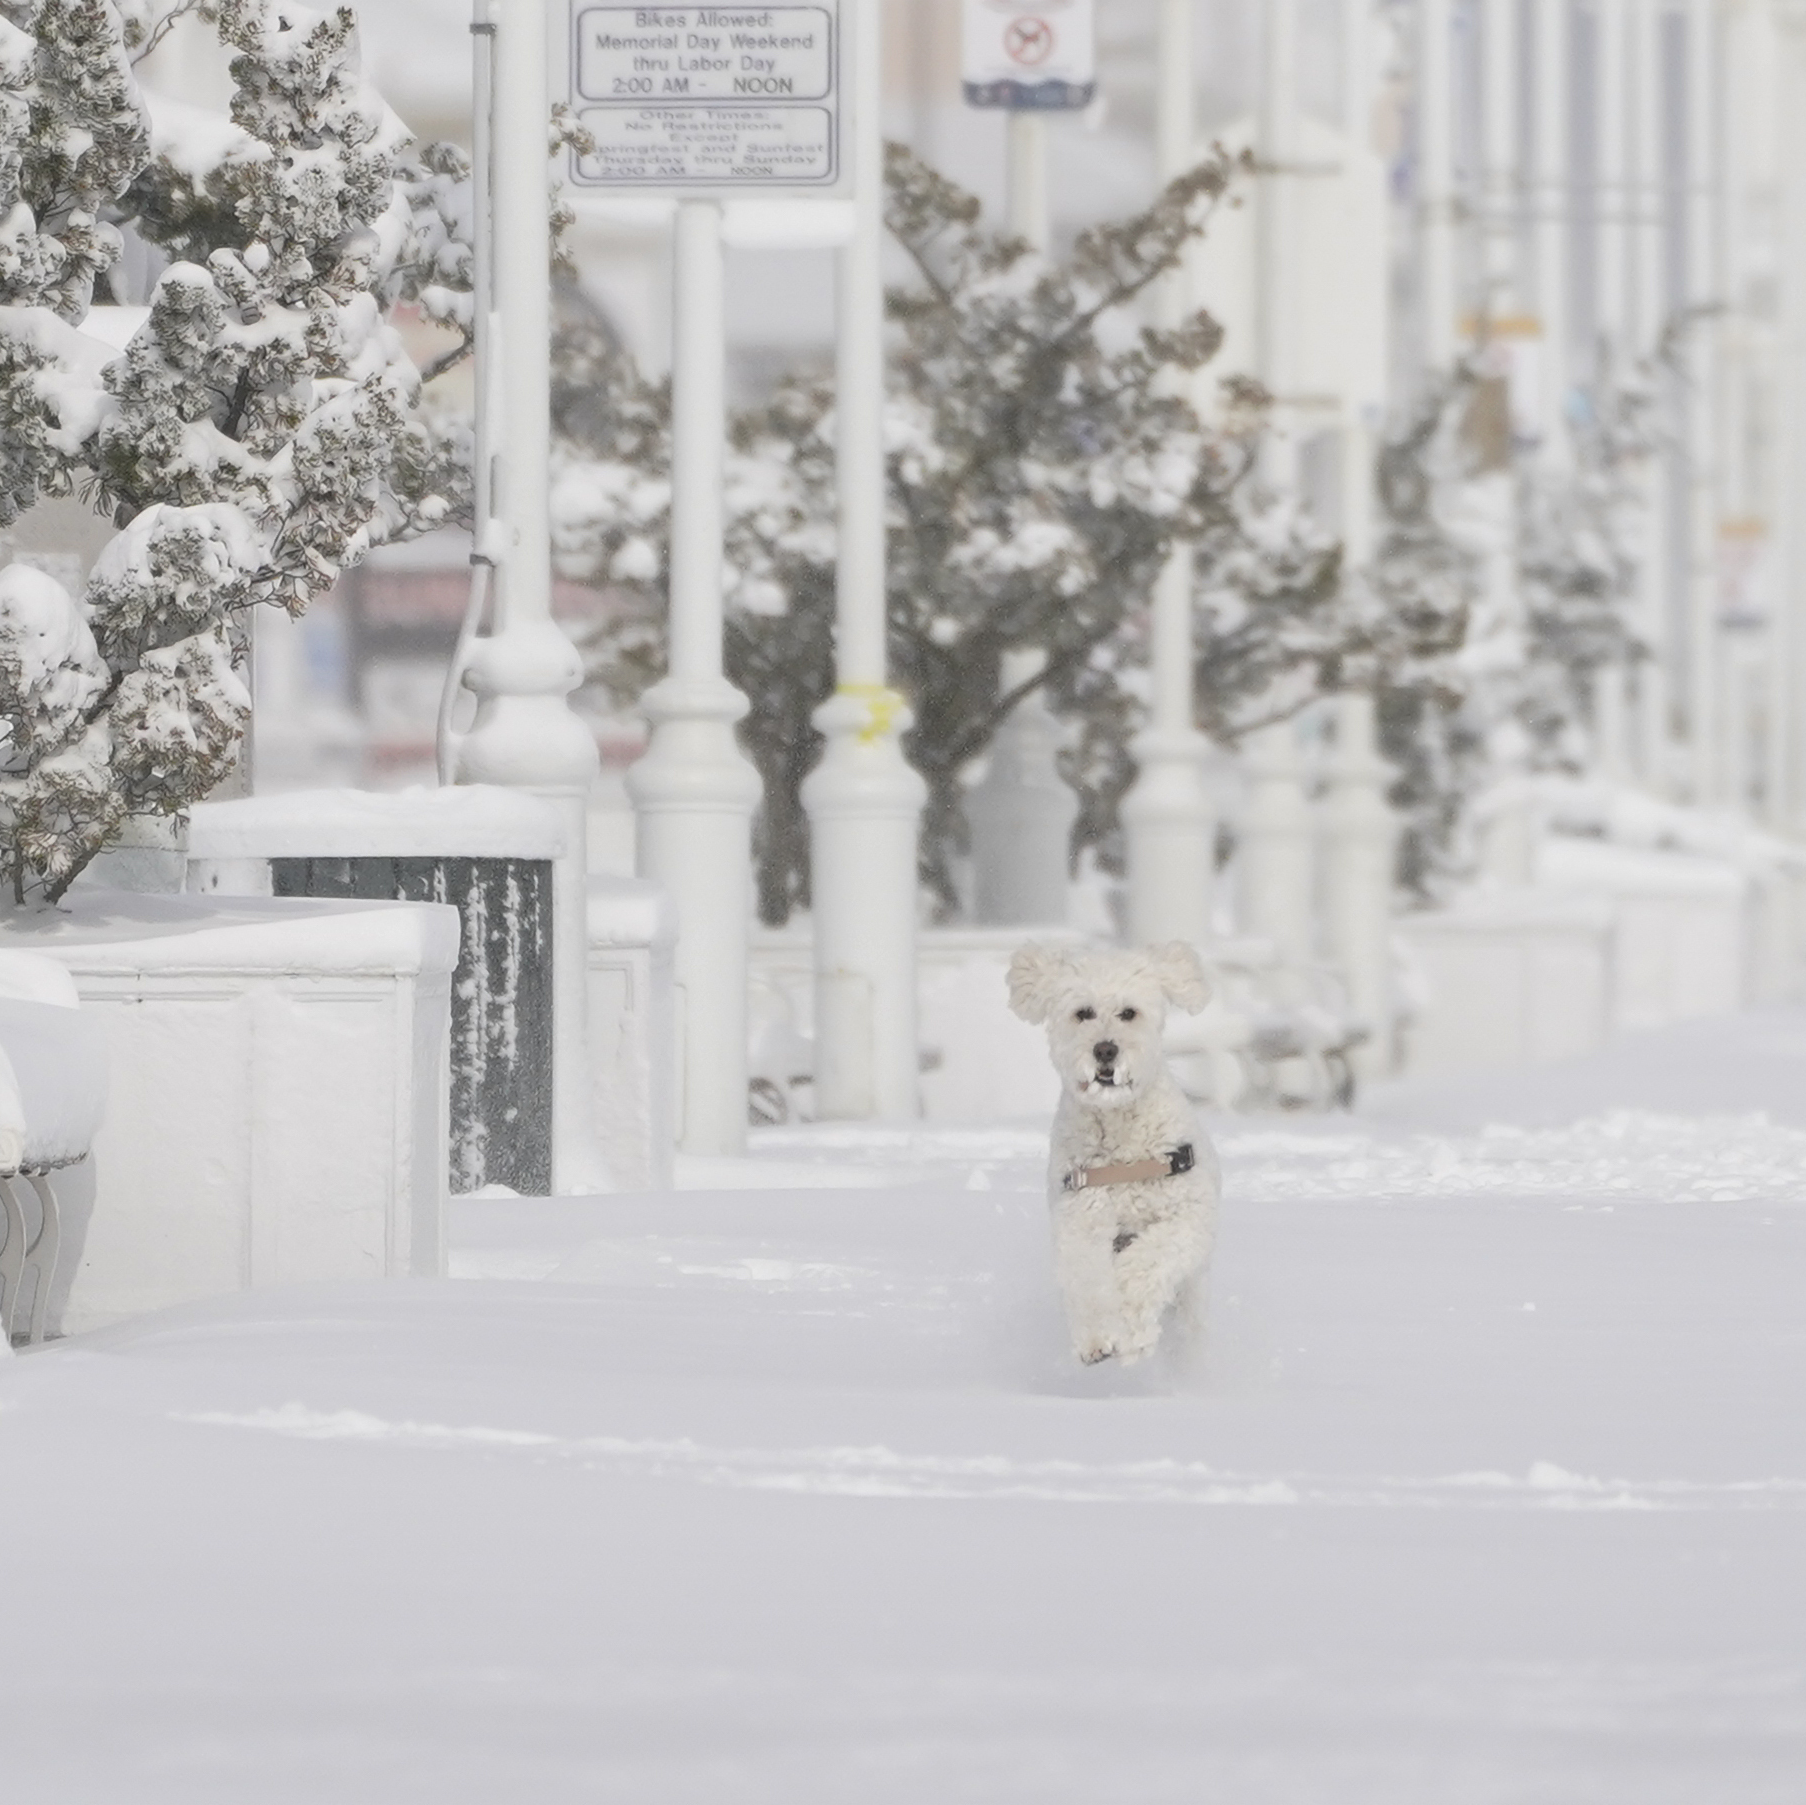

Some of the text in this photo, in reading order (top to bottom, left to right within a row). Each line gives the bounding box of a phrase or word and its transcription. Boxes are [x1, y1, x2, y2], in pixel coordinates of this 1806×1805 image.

[635, 12, 773, 28] Bikes Allowed:
[595, 33, 814, 53] Memorial Day Weekend
[633, 56, 776, 74] thru Labor Day
[612, 77, 653, 93] 2:00
[661, 77, 690, 93] AM
[733, 77, 794, 93] NOON
[639, 110, 695, 120] Other
[624, 122, 784, 131] No Restrictions
[669, 133, 740, 143] Except
[594, 144, 690, 155] pringfest
[700, 144, 737, 154] and
[595, 155, 817, 165] Thursday thru Sunday
[655, 166, 686, 176] AM
[730, 166, 773, 176] NOON
